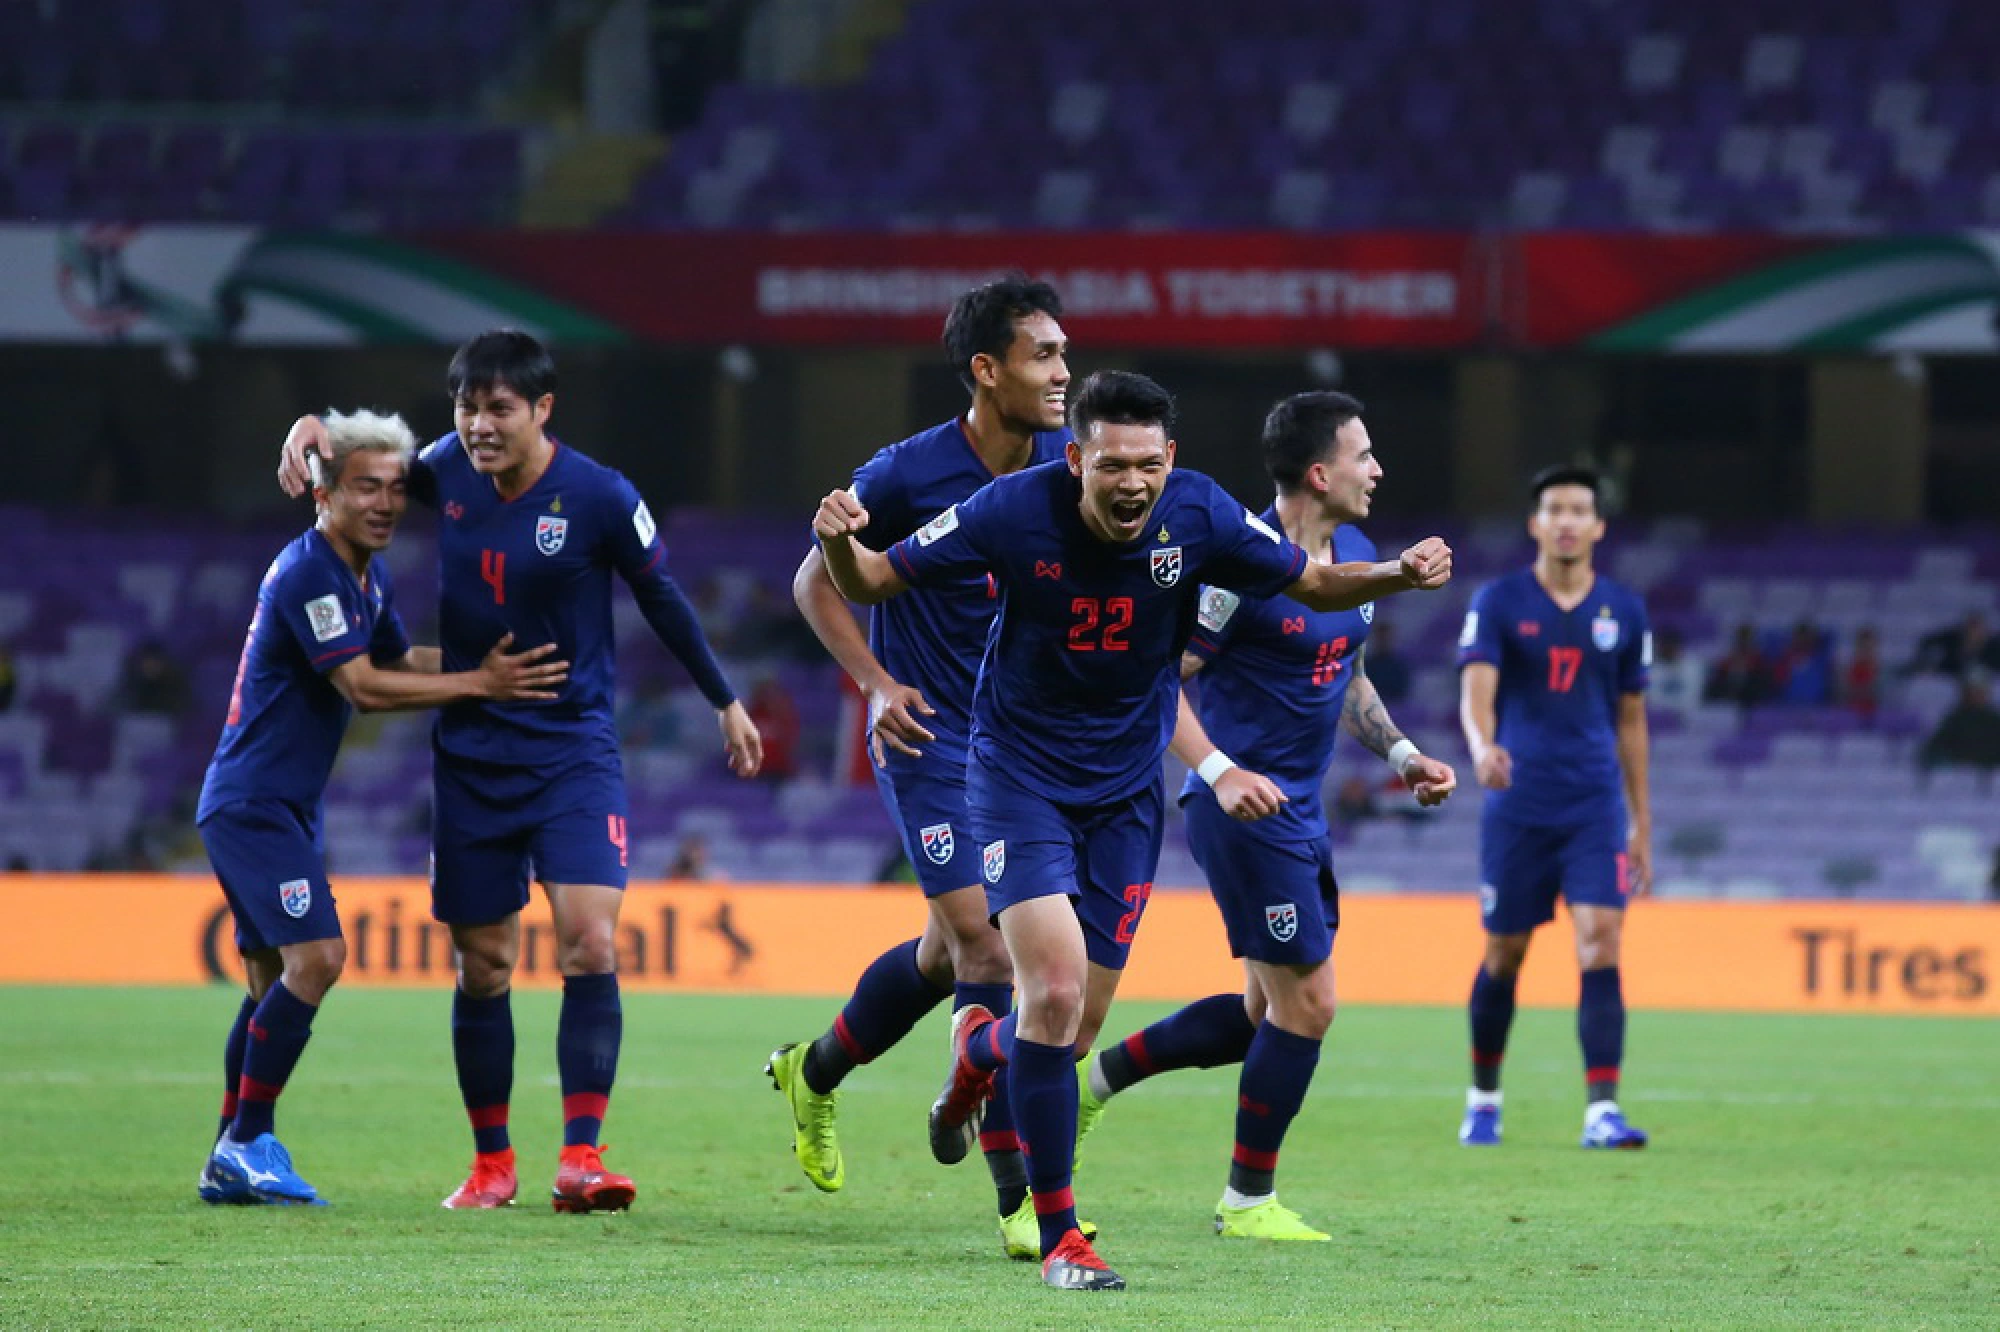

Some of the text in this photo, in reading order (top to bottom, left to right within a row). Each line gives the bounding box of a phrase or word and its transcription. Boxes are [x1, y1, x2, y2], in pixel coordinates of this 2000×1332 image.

[757, 267, 1012, 315] BRINGIN
[1166, 269, 1456, 316] TOGETHER
[481, 549, 506, 605] 4
[1068, 597, 1133, 651] 22
[1548, 645, 1583, 692] 17
[607, 813, 627, 867] 4
[1116, 881, 1153, 943] 2
[1794, 927, 1987, 1000] Tires
